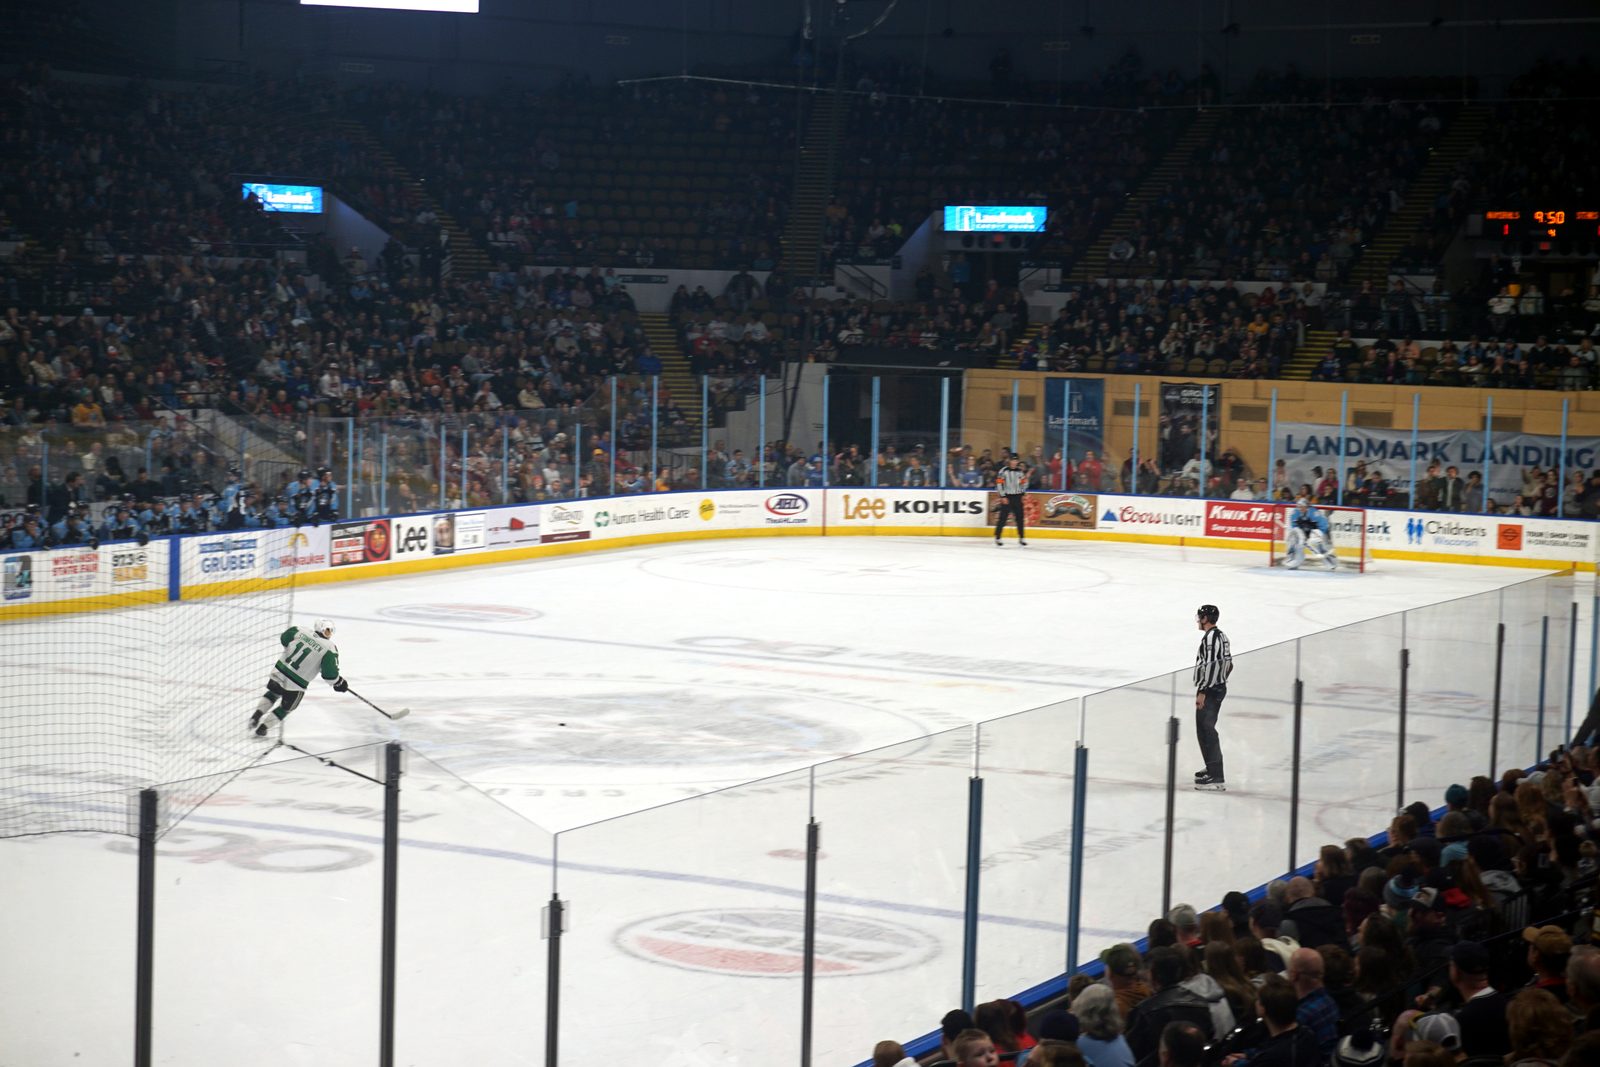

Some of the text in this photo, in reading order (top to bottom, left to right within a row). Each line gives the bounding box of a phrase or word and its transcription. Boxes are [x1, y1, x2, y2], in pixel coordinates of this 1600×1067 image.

[976, 212, 1035, 224] Landmark
[1534, 211, 1565, 224] 9:50
[1285, 434, 1595, 469] LANDMARK LANDING
[773, 498, 801, 509] AHL
[843, 494, 886, 519] Lee
[894, 500, 983, 514] KOHL'S
[612, 506, 690, 525] Aurora Health Care
[1120, 505, 1203, 526] Coors LIGHT
[395, 523, 428, 553] Lee
[1425, 520, 1487, 537] Children's
[52, 562, 98, 576] STATE FAIR
[201, 553, 256, 573] GRUBER
[285, 641, 312, 671] 11
